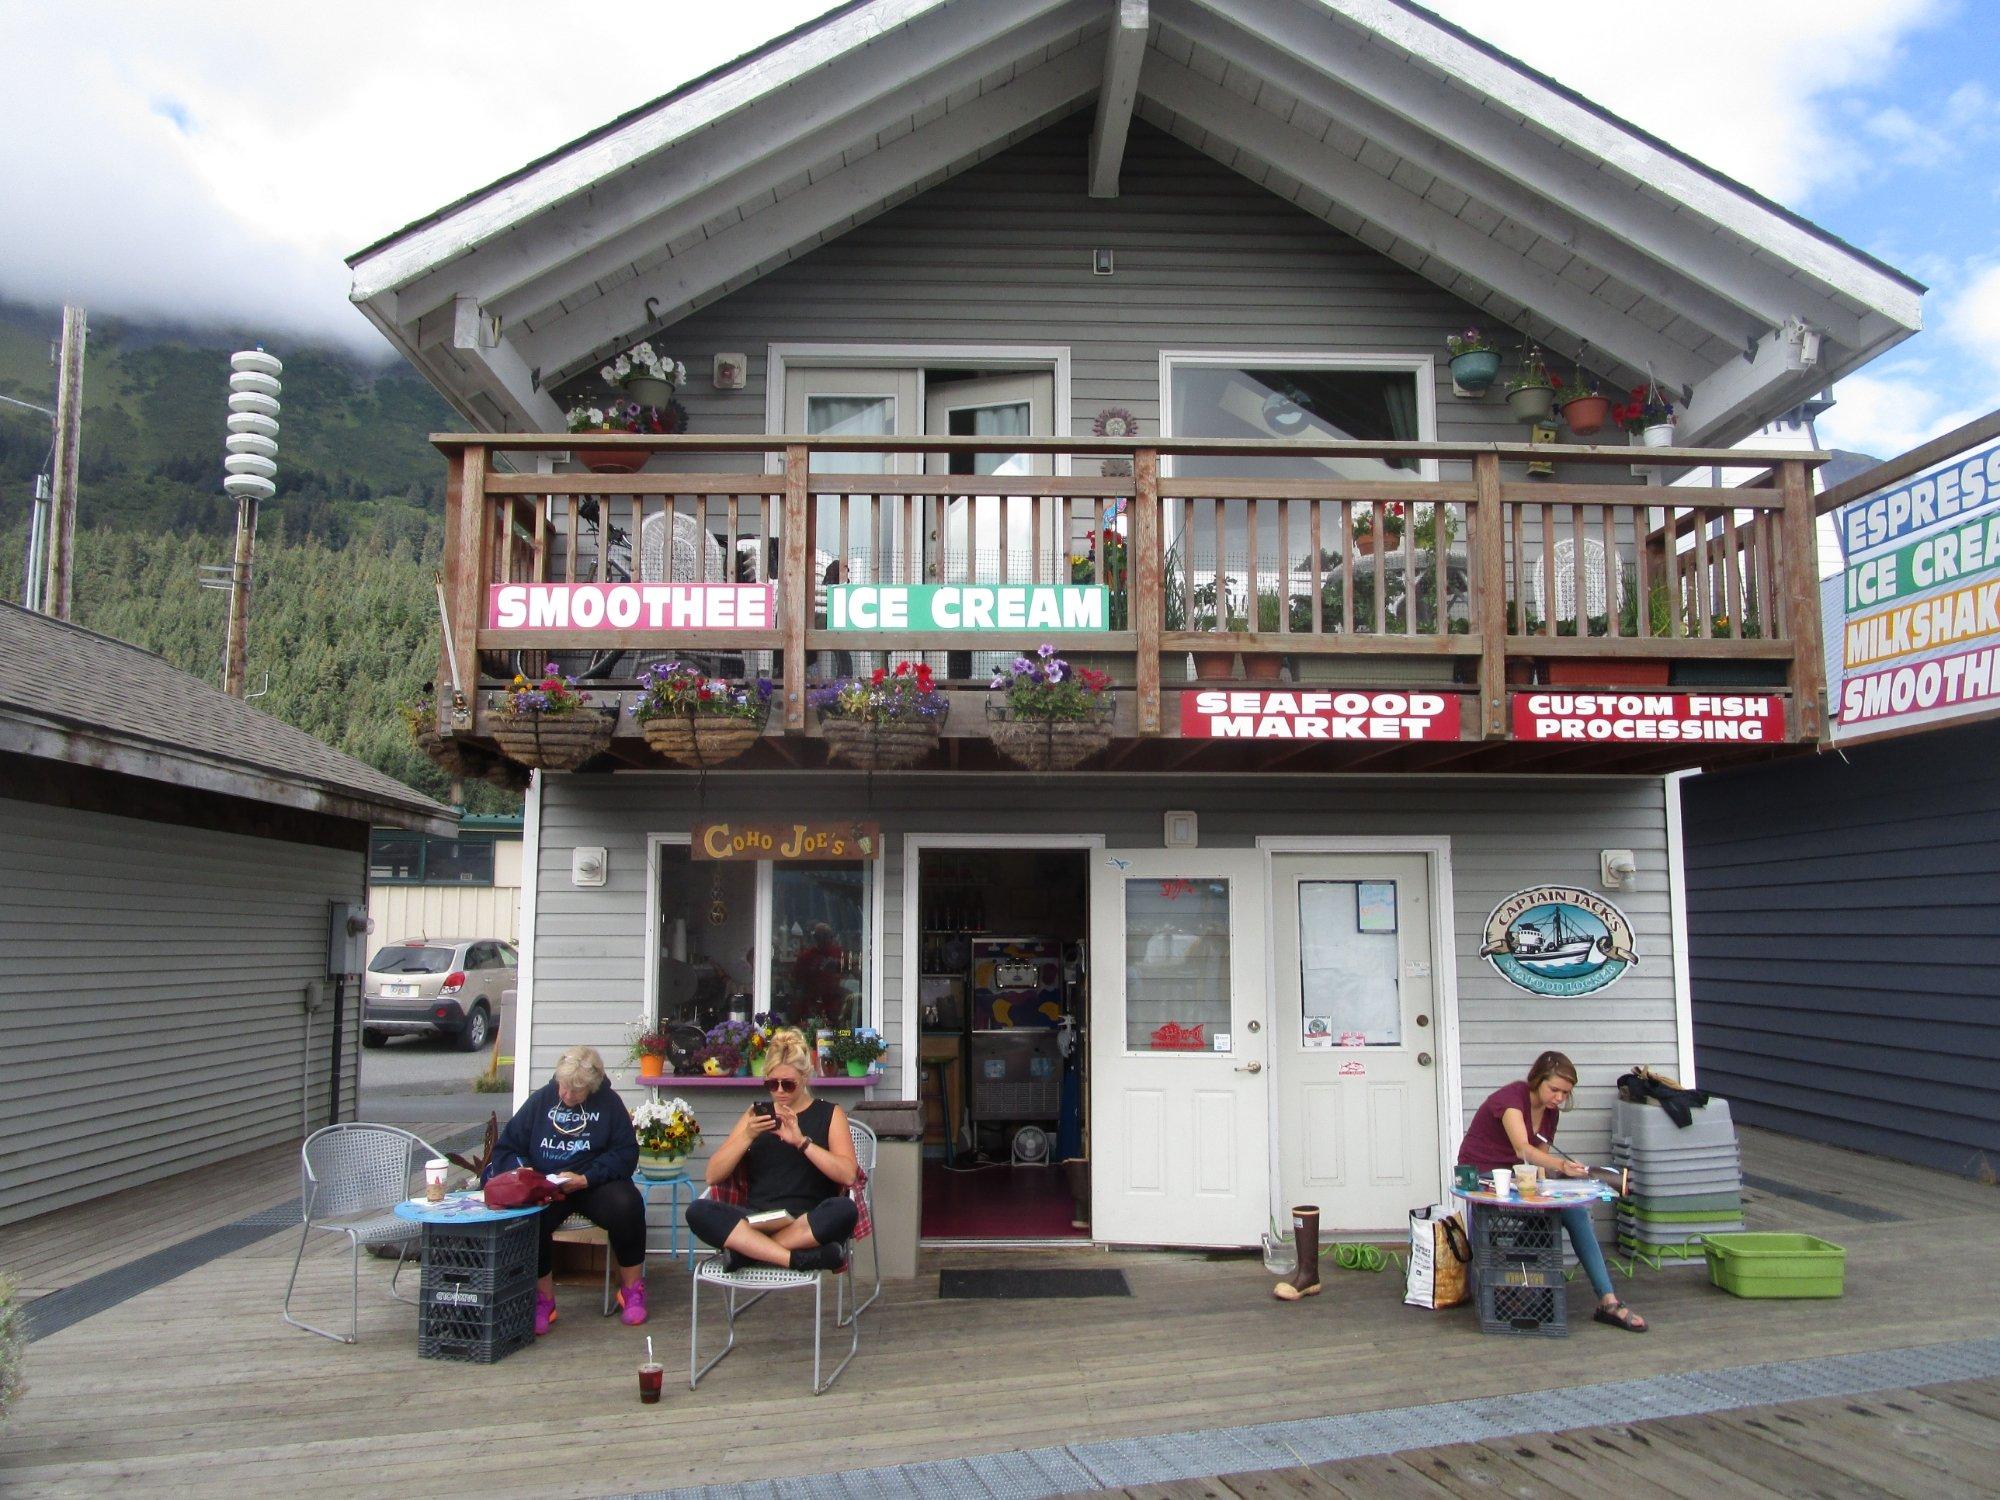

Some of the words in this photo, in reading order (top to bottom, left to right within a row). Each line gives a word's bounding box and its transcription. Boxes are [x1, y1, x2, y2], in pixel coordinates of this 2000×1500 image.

[1848, 553, 1897, 609] ICE
[497, 585, 766, 628] SMOOTHEE
[832, 586, 908, 629] ICE
[931, 586, 1102, 629] CREAM
[1847, 582, 2000, 666] MILKSHAK
[1196, 691, 1445, 716] SEAFOOD
[1528, 695, 1674, 716] CUSTOM
[1689, 697, 1769, 717] FISH
[1210, 716, 1431, 739] MARKET
[1536, 718, 1763, 740] PROCESSING
[1498, 891, 1567, 926] CAPTAIN
[1572, 893, 1620, 932] JACK'S
[1505, 960, 1564, 992] SEAFOOD
[548, 1110, 600, 1122] OREGON
[540, 1137, 591, 1151] ALASKA
